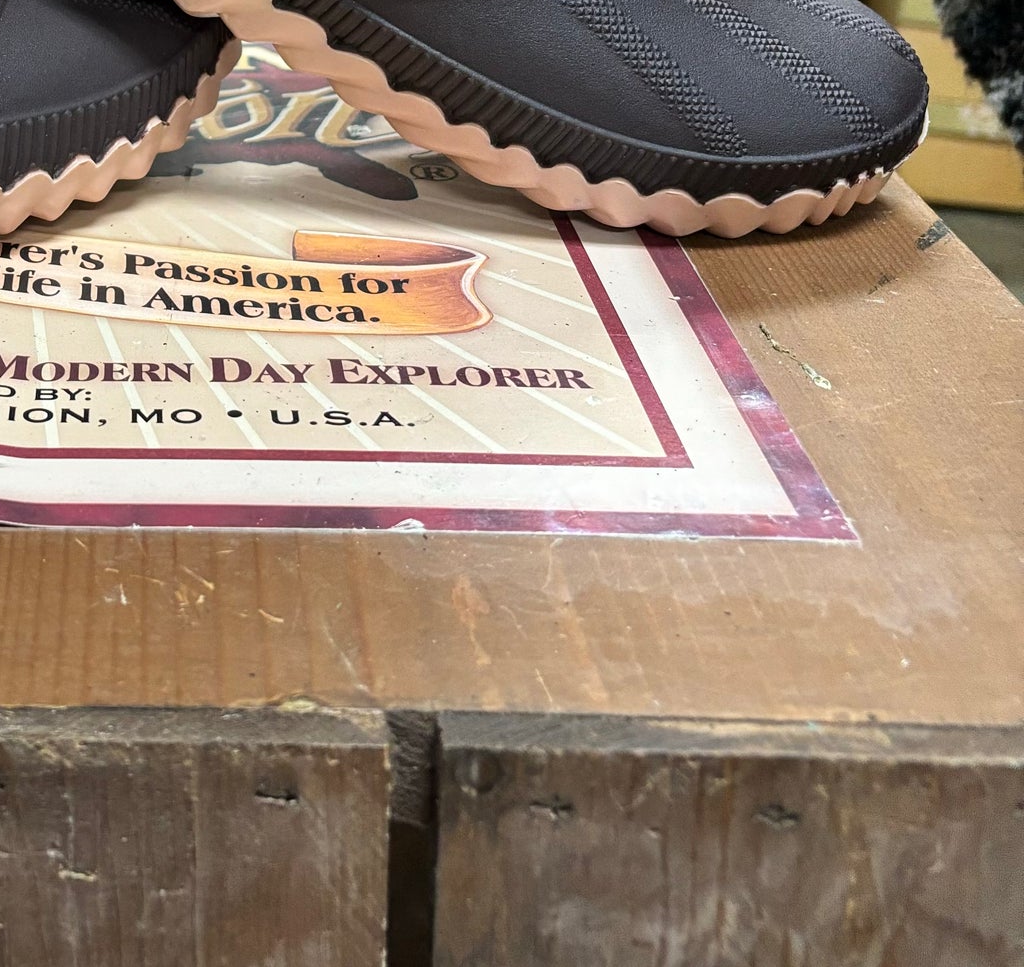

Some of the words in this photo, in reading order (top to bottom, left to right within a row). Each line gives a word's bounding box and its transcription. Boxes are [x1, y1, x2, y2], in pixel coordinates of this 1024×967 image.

[123, 252, 323, 293] Passion
[339, 272, 409, 295] for
[79, 276, 127, 306] in
[142, 287, 380, 323] America.
[209, 356, 315, 384] DAY
[327, 358, 594, 390] EXPLORER
[34, 388, 93, 401] BY:
[130, 408, 203, 424] MO
[269, 409, 416, 427] U.S.A.
